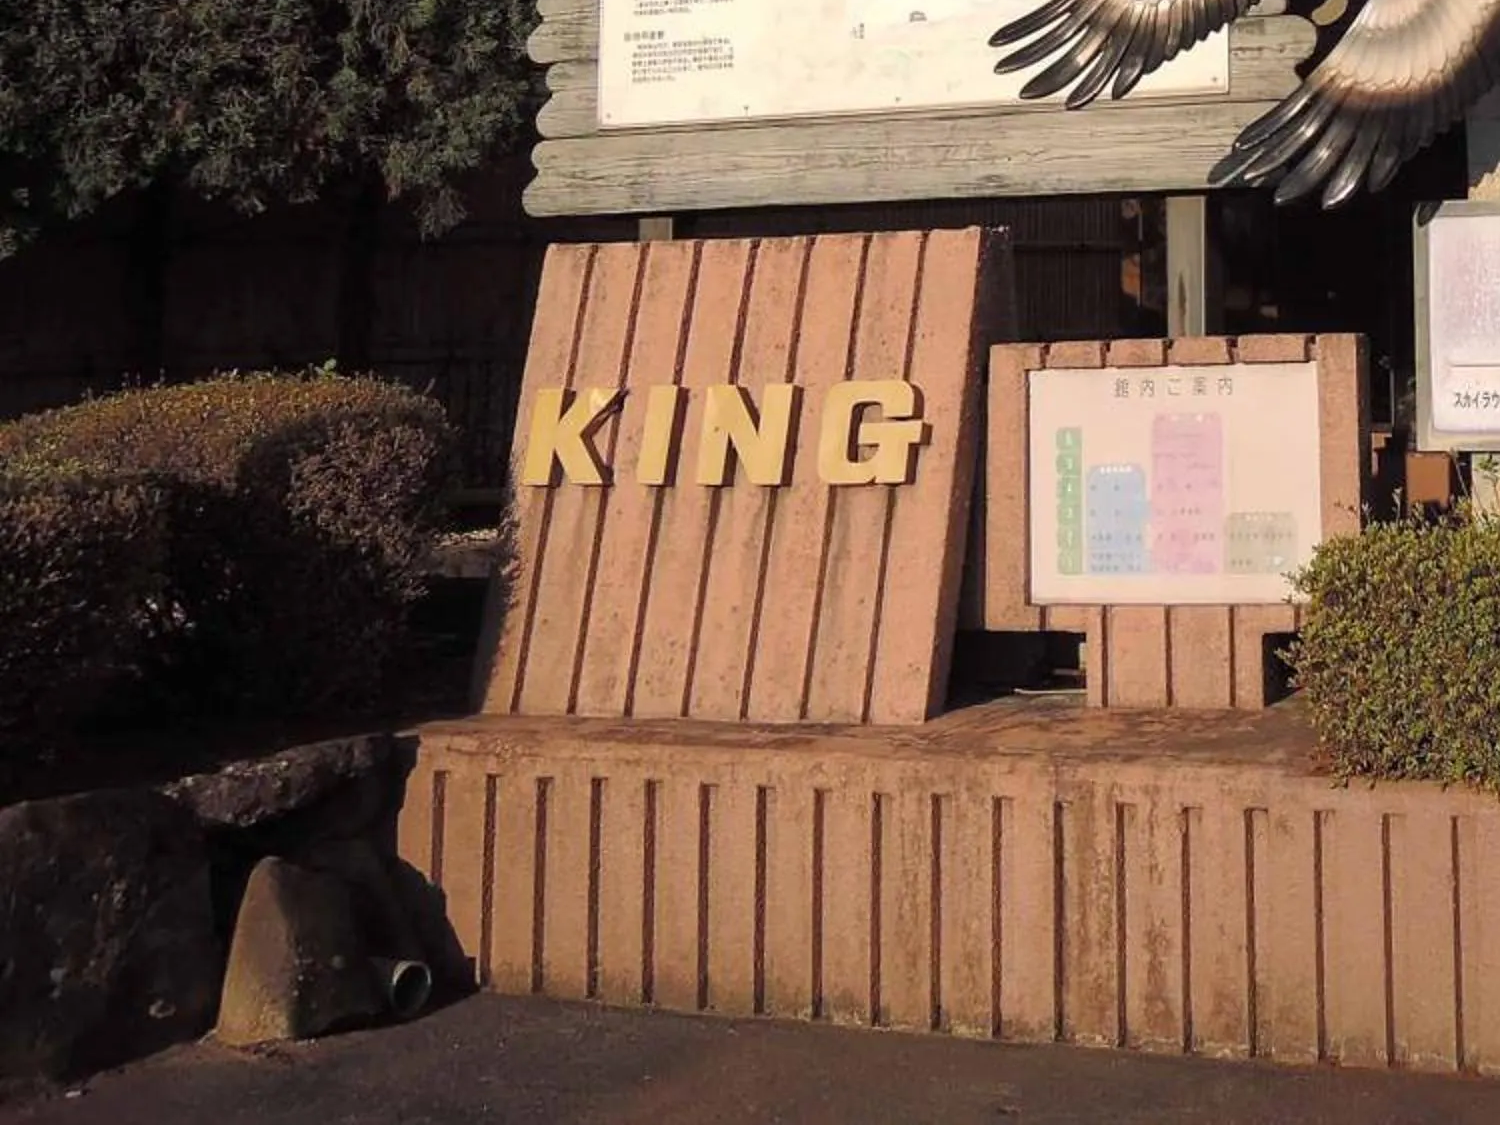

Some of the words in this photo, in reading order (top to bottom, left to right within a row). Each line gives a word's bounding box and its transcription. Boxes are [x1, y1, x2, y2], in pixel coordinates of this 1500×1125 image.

[1114, 376, 1234, 398] 館内ご案内
[523, 379, 926, 487] KING
